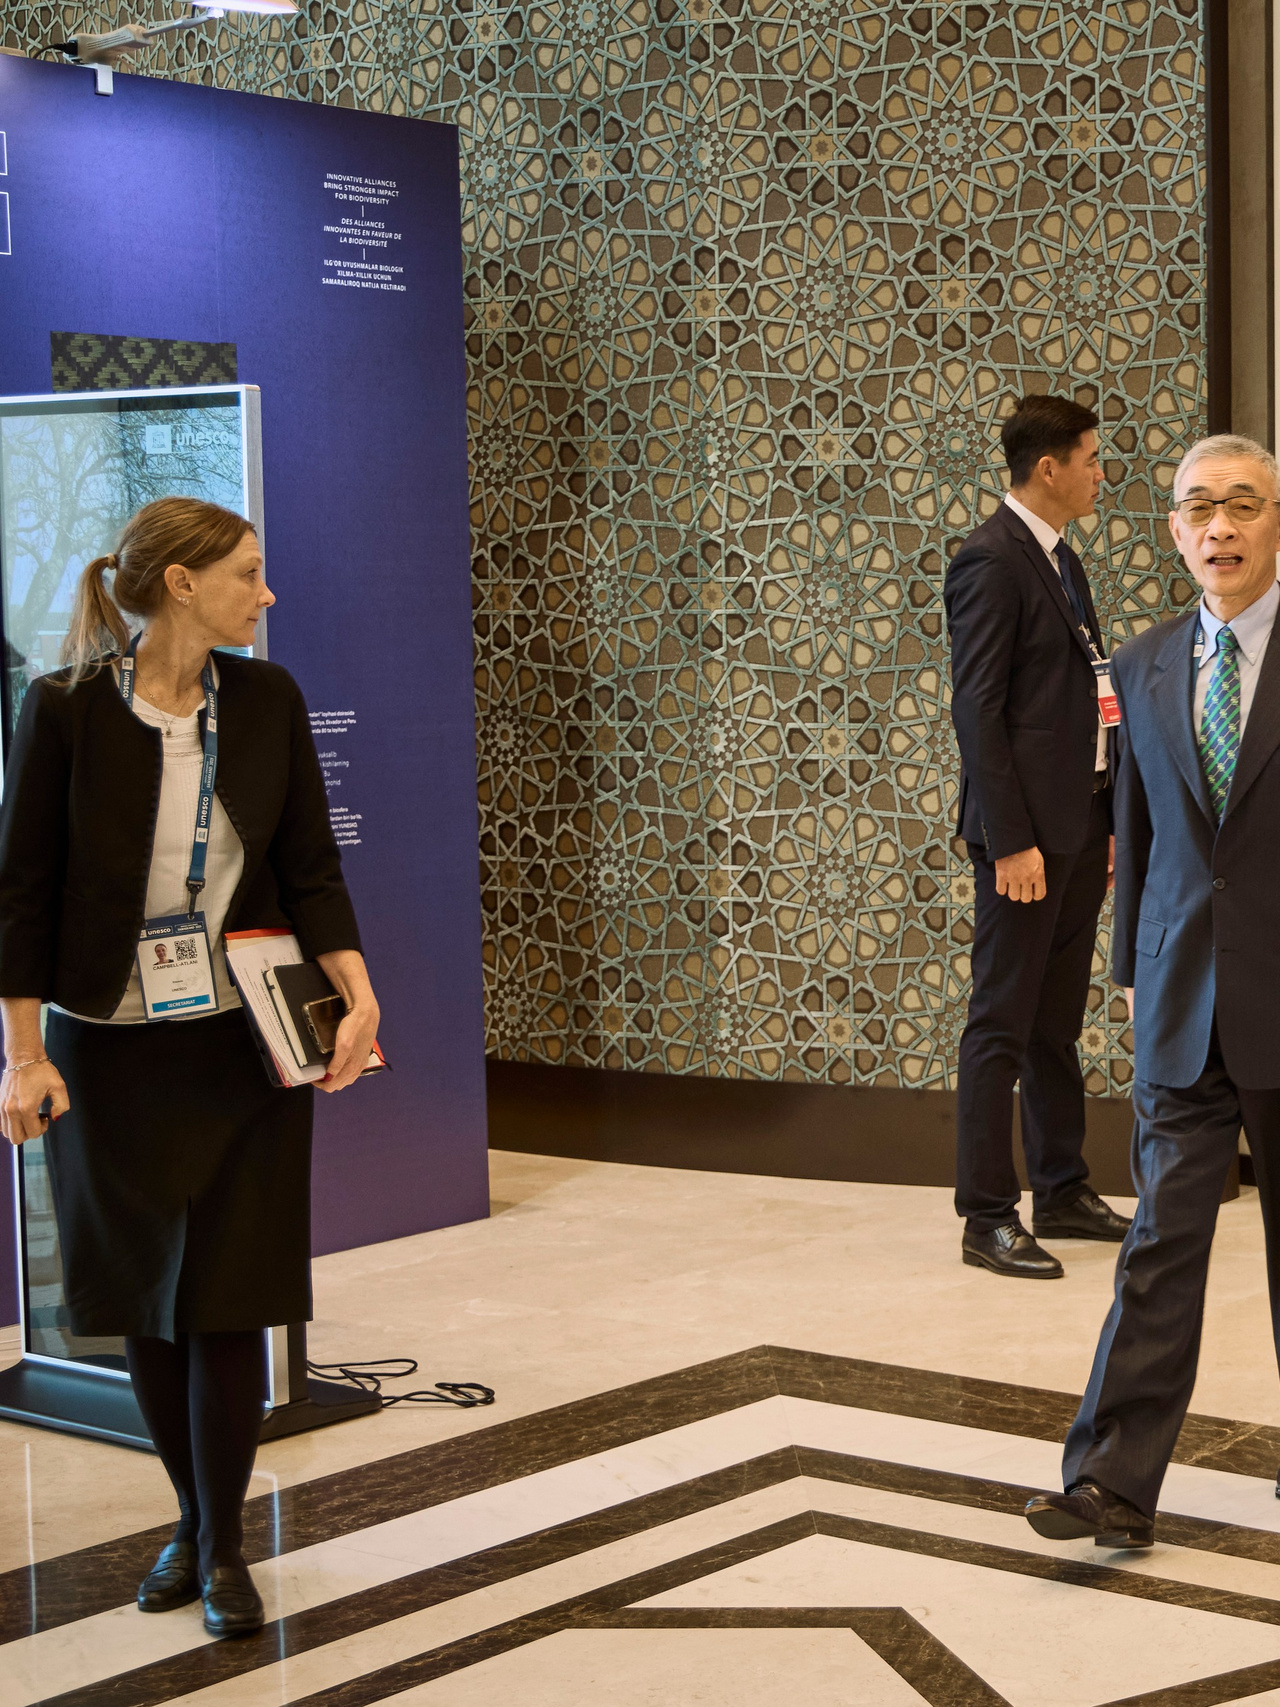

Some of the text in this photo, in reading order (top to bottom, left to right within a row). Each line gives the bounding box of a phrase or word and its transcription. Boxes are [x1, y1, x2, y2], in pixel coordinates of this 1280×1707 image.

[326, 173, 397, 188] INNOVATIVE ALLIANCES
[323, 181, 399, 197] BRING STRONGER IMPACT
[334, 192, 390, 205] FOR BIODIVERSITY
[353, 219, 385, 229] ALLIANCES
[323, 225, 361, 236] INNOVANTES
[371, 230, 393, 239] FAVEUR
[348, 237, 388, 248] BIODIVERSITÉ
[342, 261, 378, 271] UYUSHMALAR
[379, 264, 404, 273] BIOLOGIK
[336, 269, 392, 281] XILMA-XILLIK UCHUN
[321, 277, 361, 288] SAMARALIROQ
[380, 283, 407, 292] KELTIRADI
[175, 430, 230, 446] unesco
[122, 671, 131, 699] unesco
[207, 692, 216, 717] unesco
[200, 796, 209, 826] unesco
[147, 927, 172, 936] unesco
[167, 999, 196, 1009] SECRETARIAT
